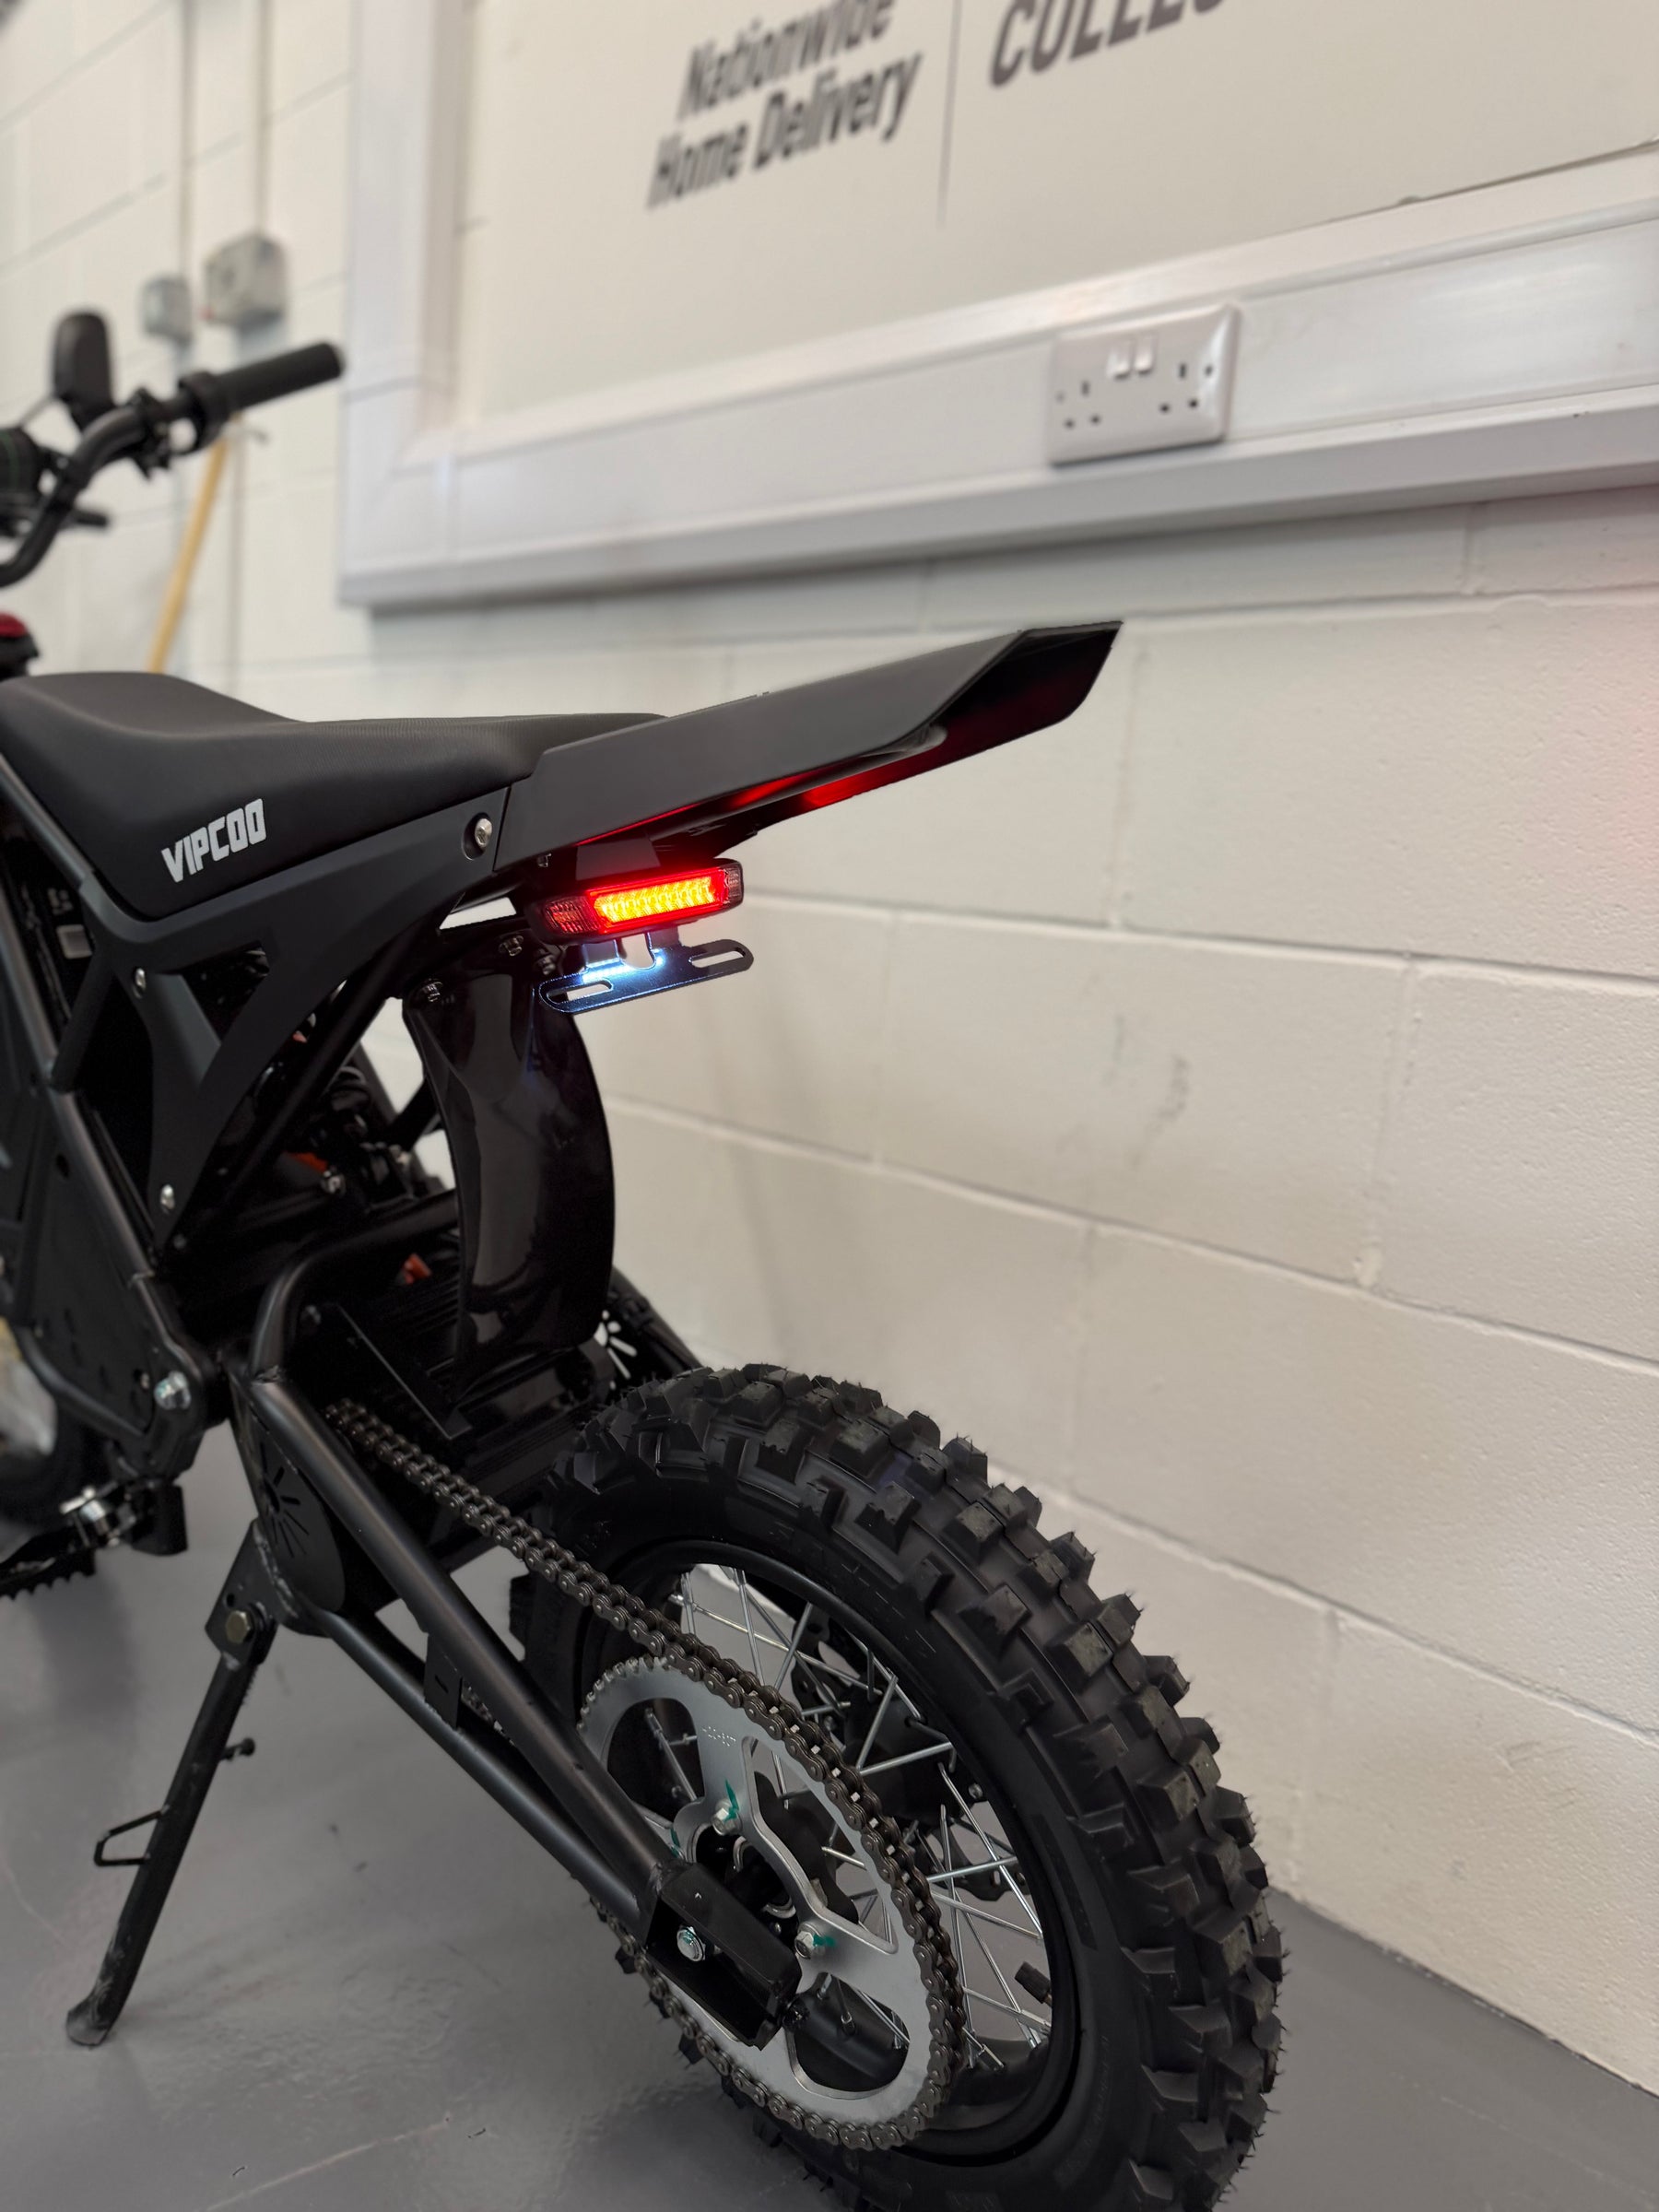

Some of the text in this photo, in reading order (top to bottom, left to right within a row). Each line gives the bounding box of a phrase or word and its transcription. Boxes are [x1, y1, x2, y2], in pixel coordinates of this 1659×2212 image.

[646, 52, 923, 210] Home Delivery
[160, 798, 267, 883] VIPCOO
